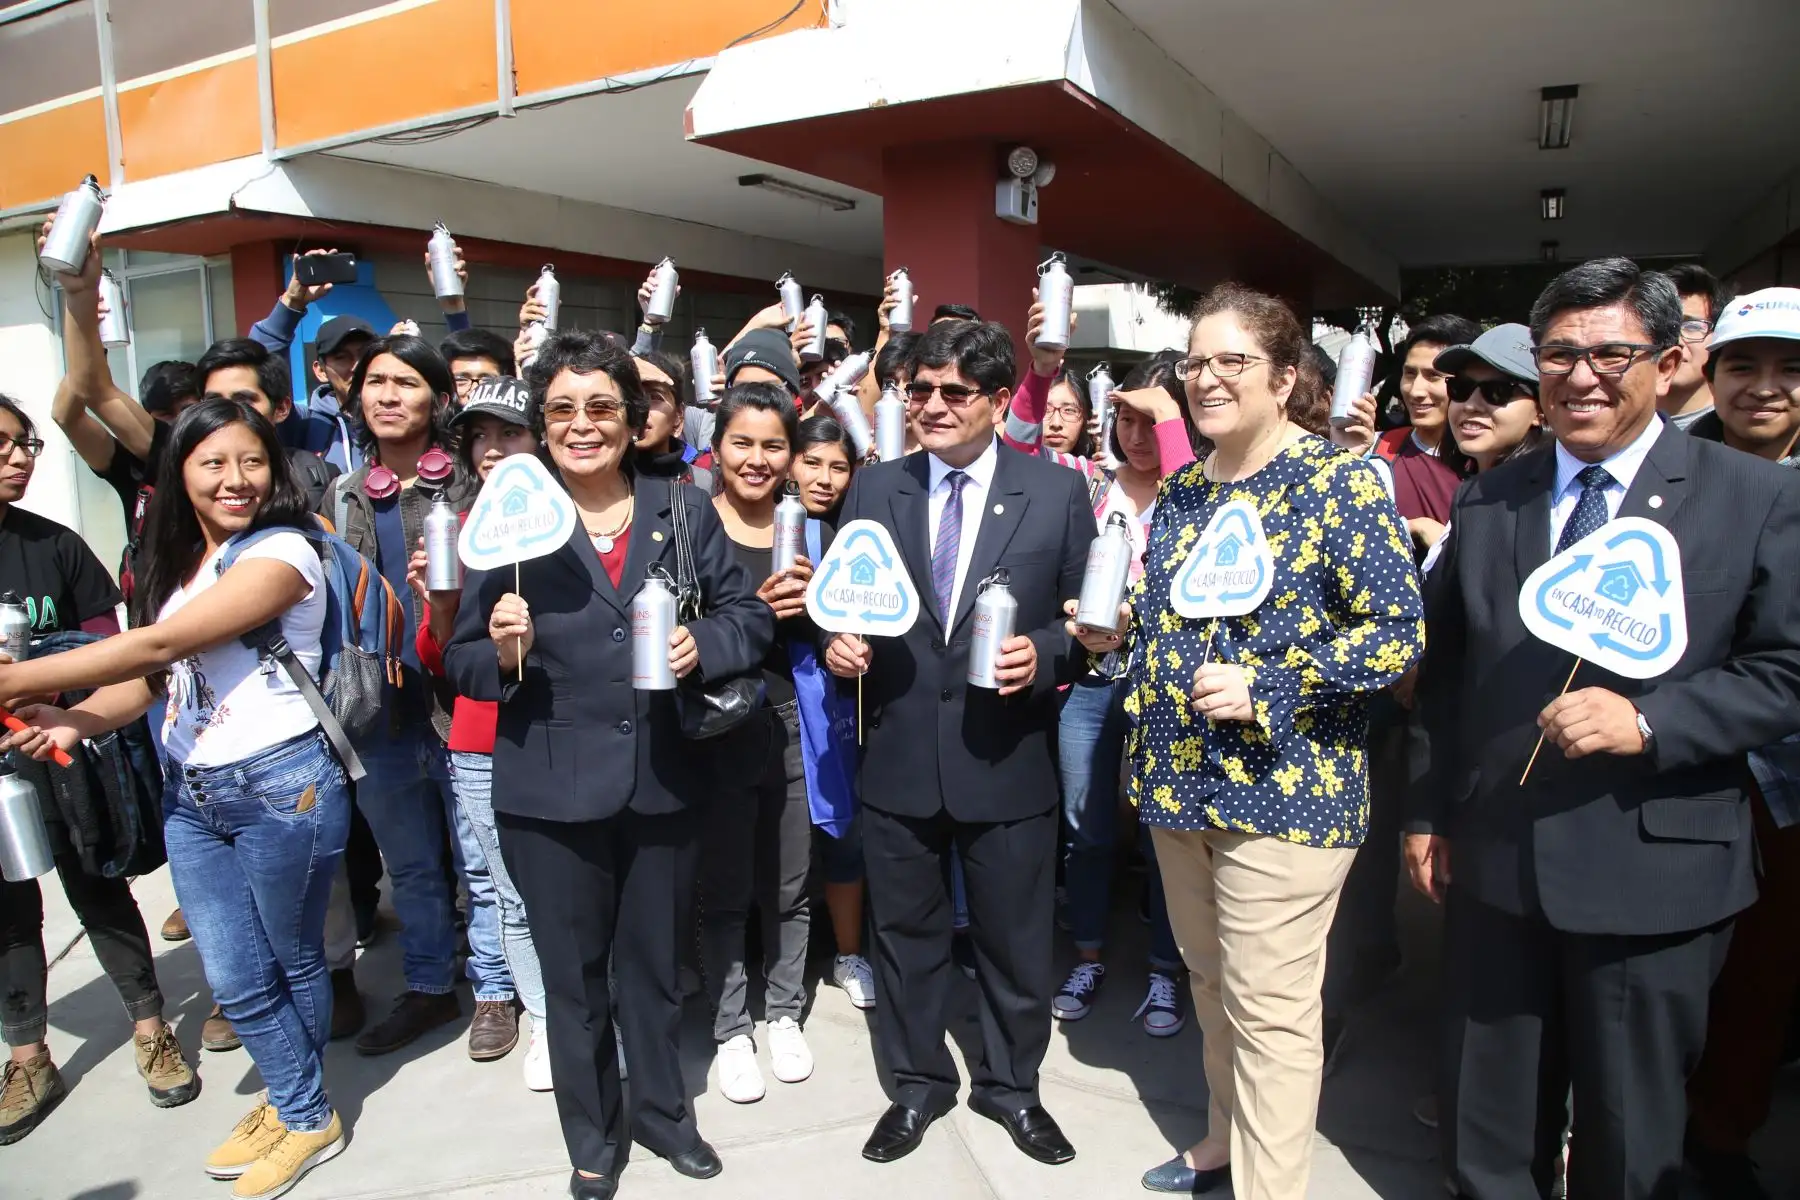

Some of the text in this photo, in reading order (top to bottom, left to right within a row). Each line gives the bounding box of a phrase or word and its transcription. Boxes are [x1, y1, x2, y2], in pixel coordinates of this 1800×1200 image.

[1223, 569, 1256, 586] RECICLO
[834, 588, 856, 604] CASA
[864, 591, 899, 609] RECICLO
[1552, 588, 1564, 600] EN
[1563, 592, 1596, 619] CASA
[1602, 608, 1658, 646] RECICLO
